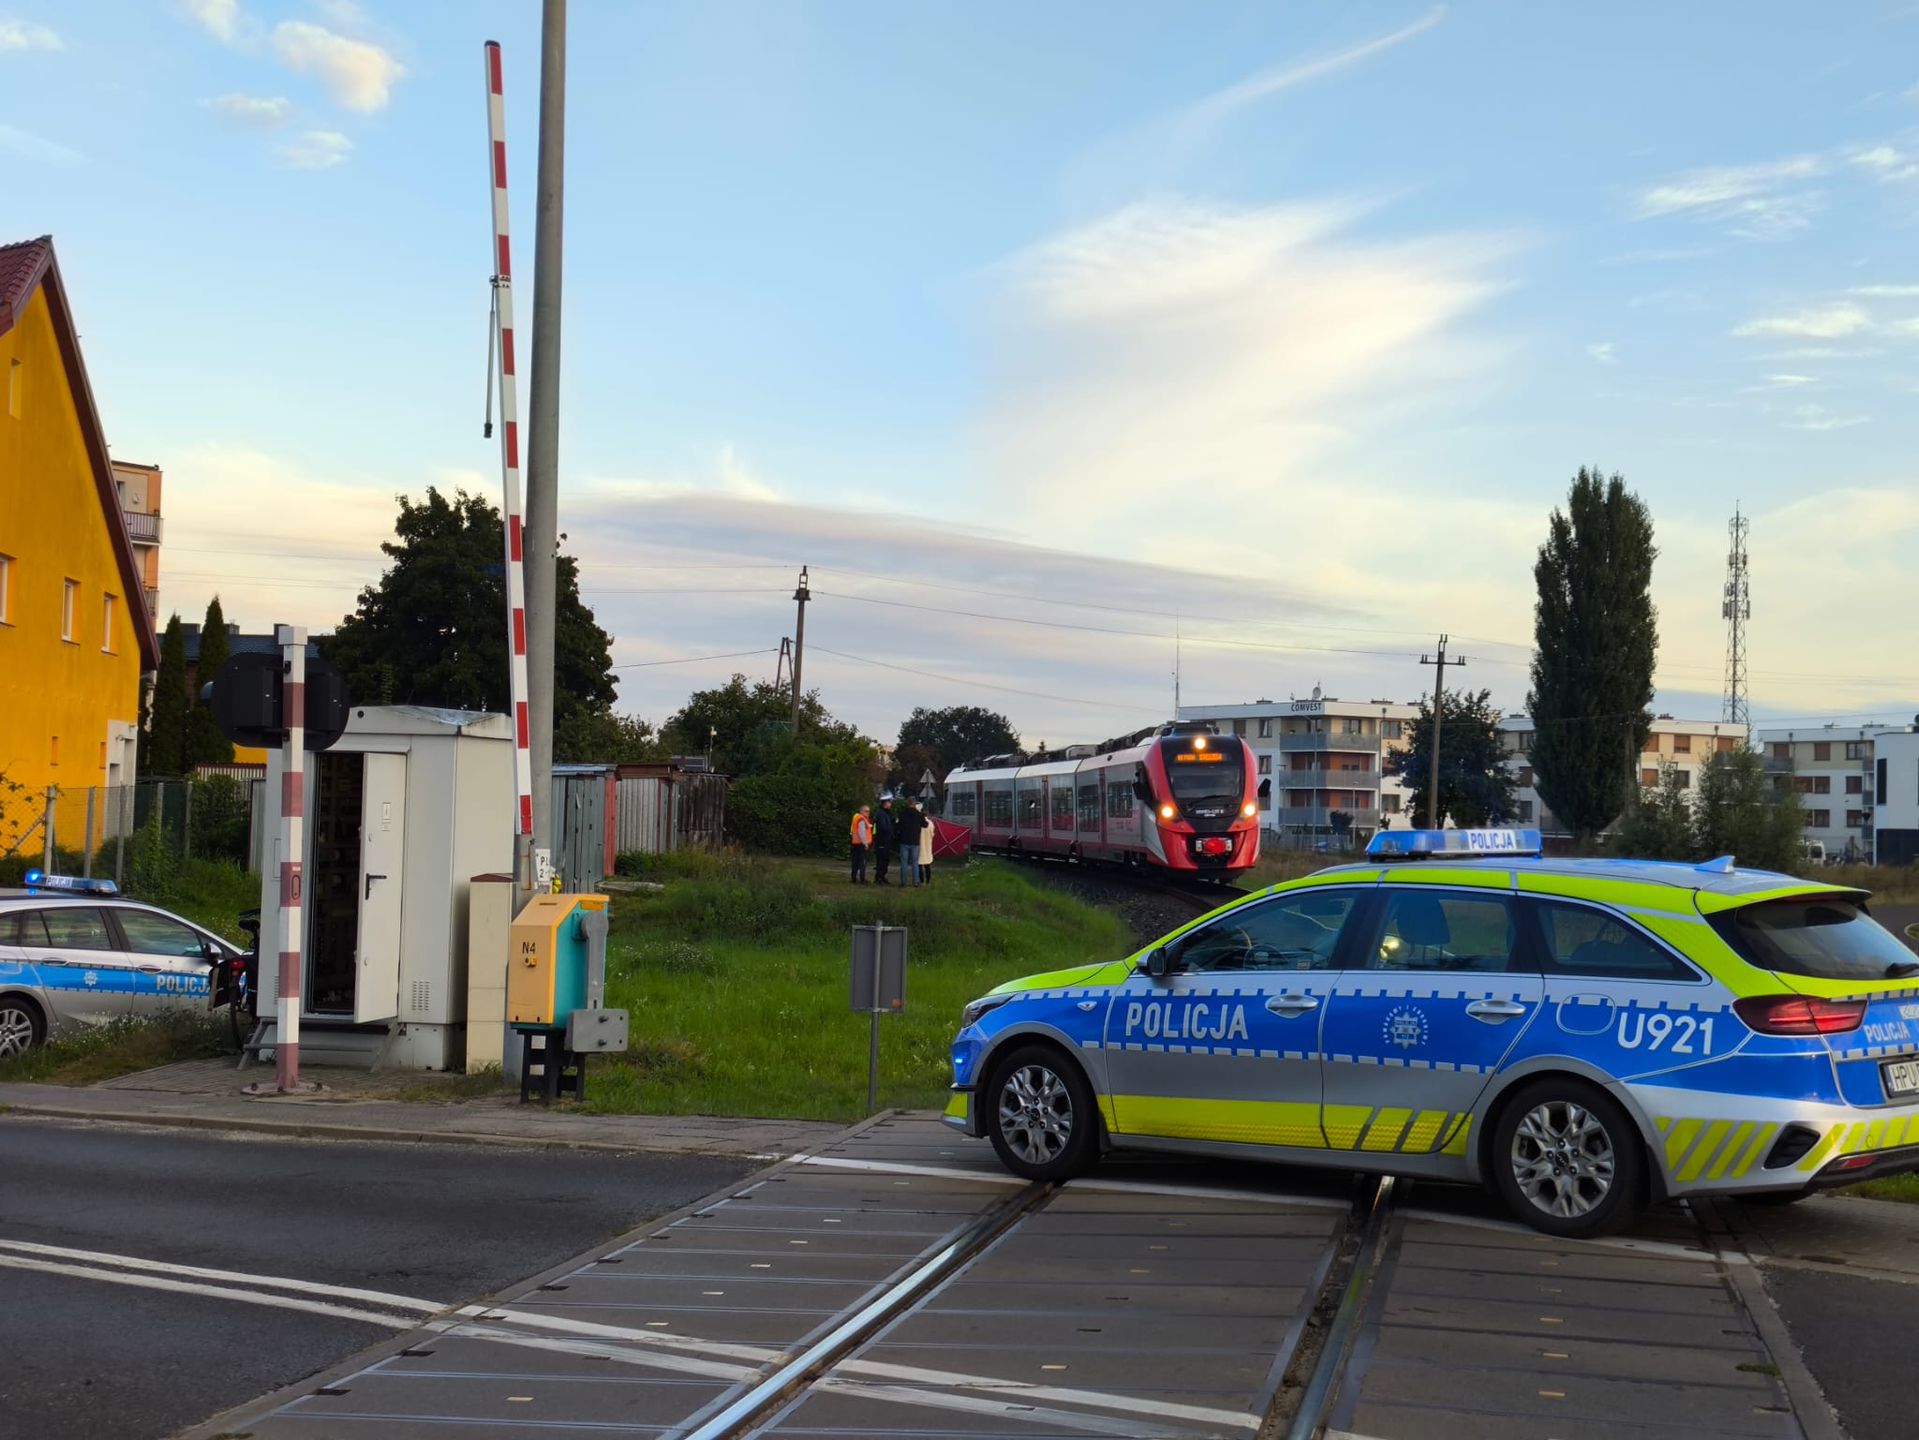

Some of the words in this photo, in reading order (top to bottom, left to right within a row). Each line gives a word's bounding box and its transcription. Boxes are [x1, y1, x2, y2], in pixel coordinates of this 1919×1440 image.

[1470, 832, 1514, 849] POLICJA
[522, 941, 536, 954] N4
[156, 974, 210, 993] POLICJ
[1125, 1002, 1248, 1040] POLICJA
[1863, 1021, 1911, 1043] POLICJA
[1617, 1011, 1713, 1055] U921
[1891, 1063, 1919, 1089] HPU
